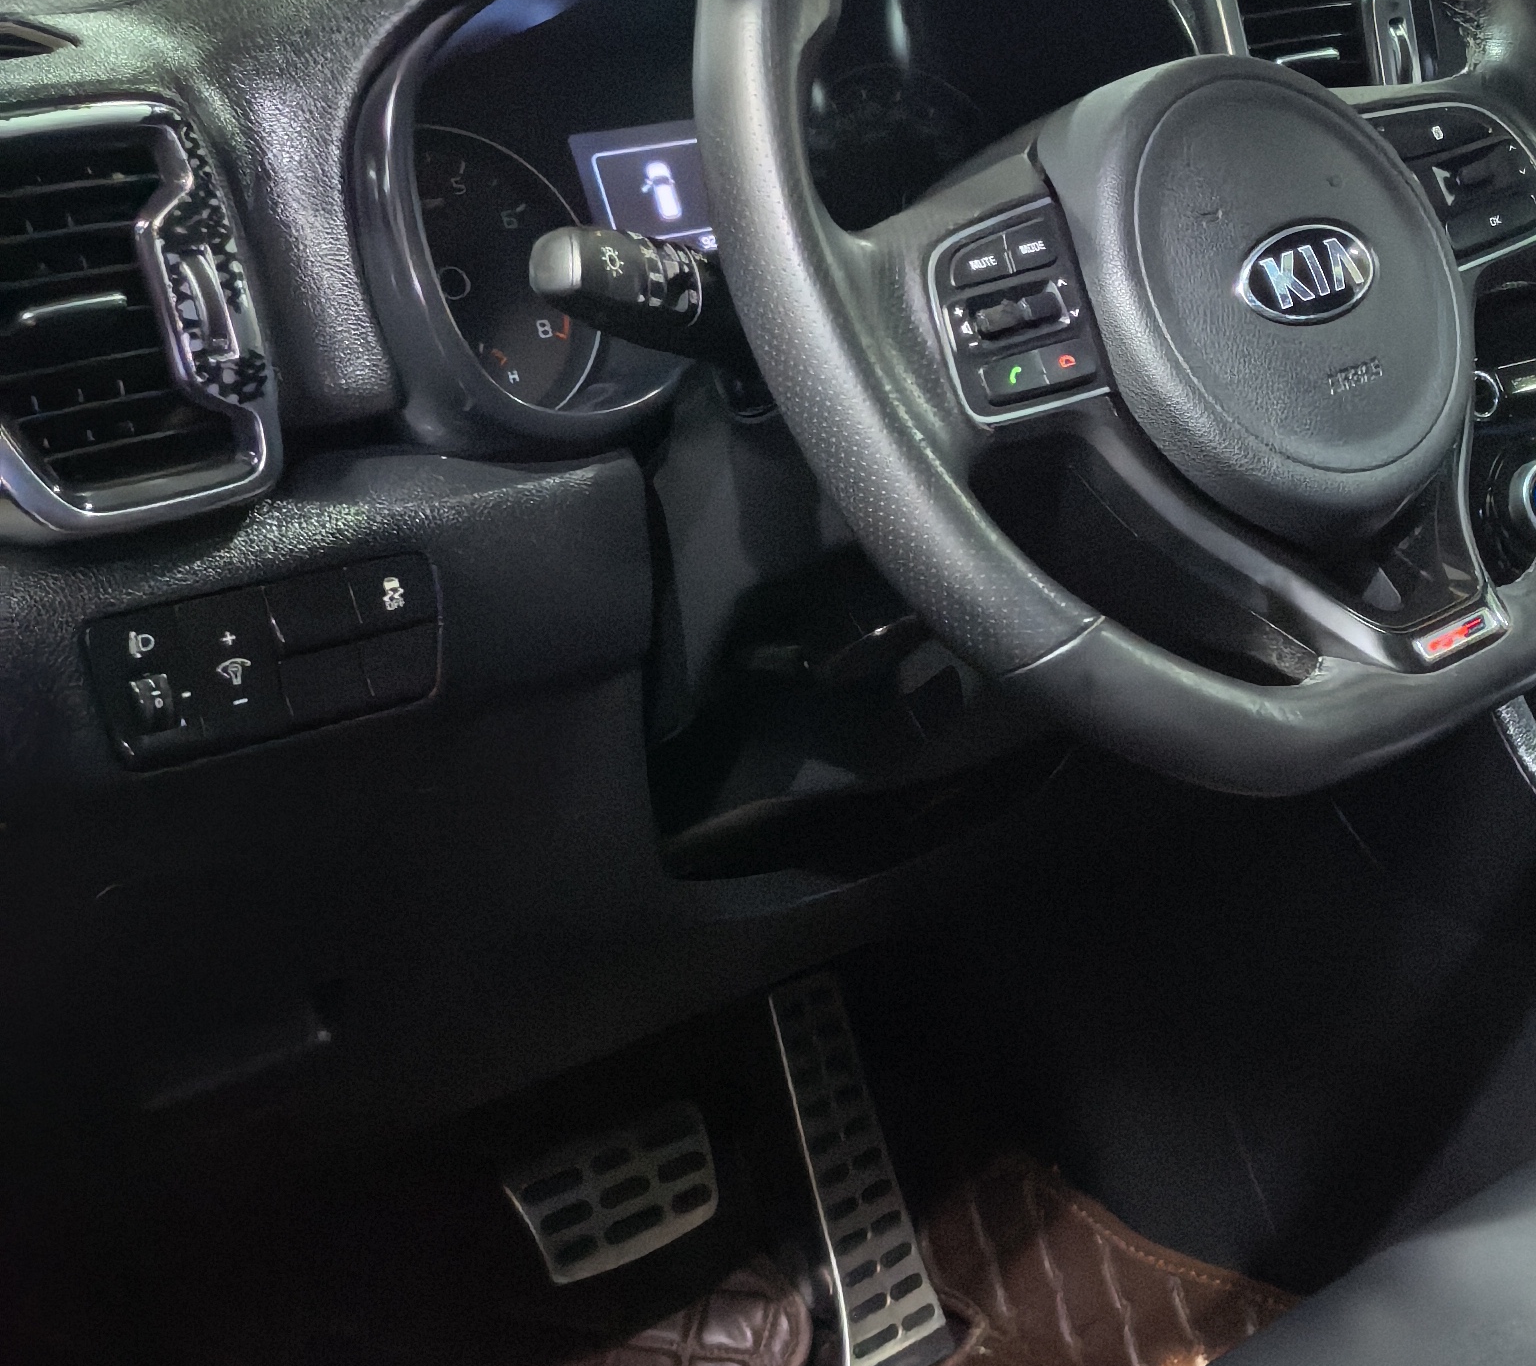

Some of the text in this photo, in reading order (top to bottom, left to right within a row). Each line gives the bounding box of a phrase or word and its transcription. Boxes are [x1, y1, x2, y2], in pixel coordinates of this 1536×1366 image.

[1489, 214, 1502, 227] OK
[968, 240, 1047, 271] MUTE MODE
[1259, 237, 1365, 310] KIA
